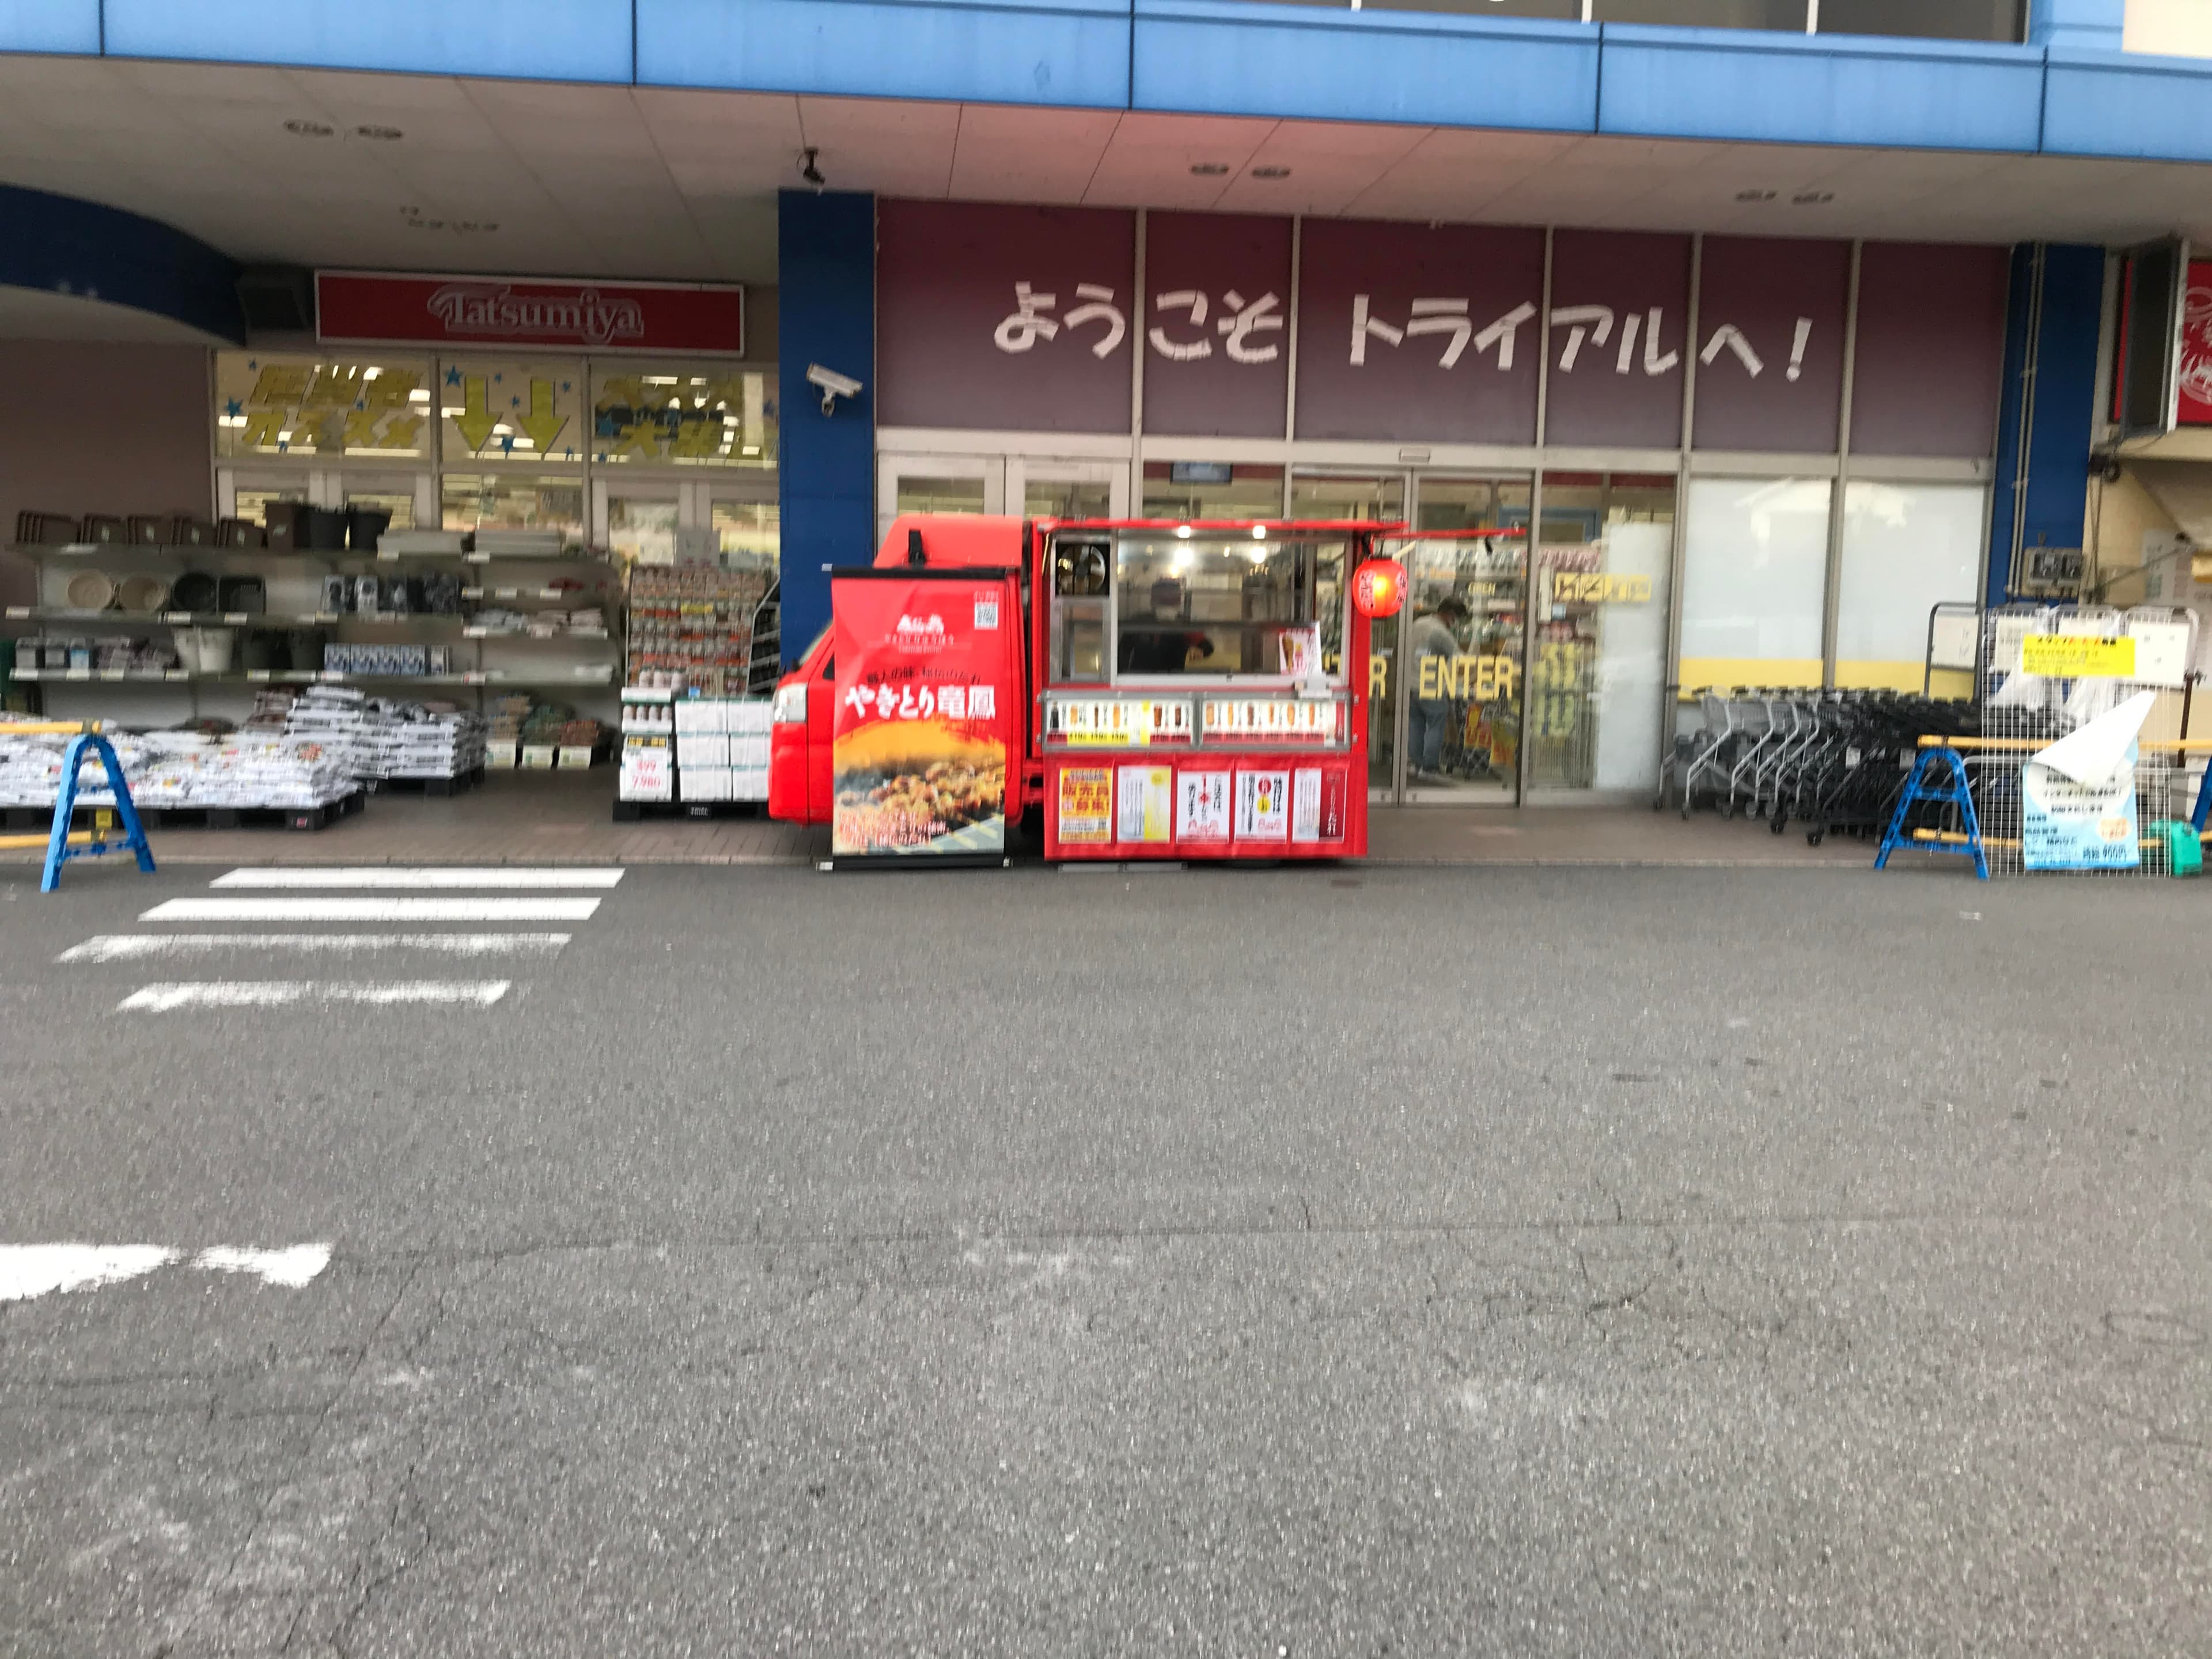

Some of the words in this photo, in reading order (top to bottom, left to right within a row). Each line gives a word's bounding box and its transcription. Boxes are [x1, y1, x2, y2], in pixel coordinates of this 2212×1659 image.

[427, 283, 645, 344] Tatsumiya
[994, 281, 1283, 364] ようこそ
[844, 682, 997, 720] やきとり竜鳳
[1419, 655, 1513, 702] ENTER
